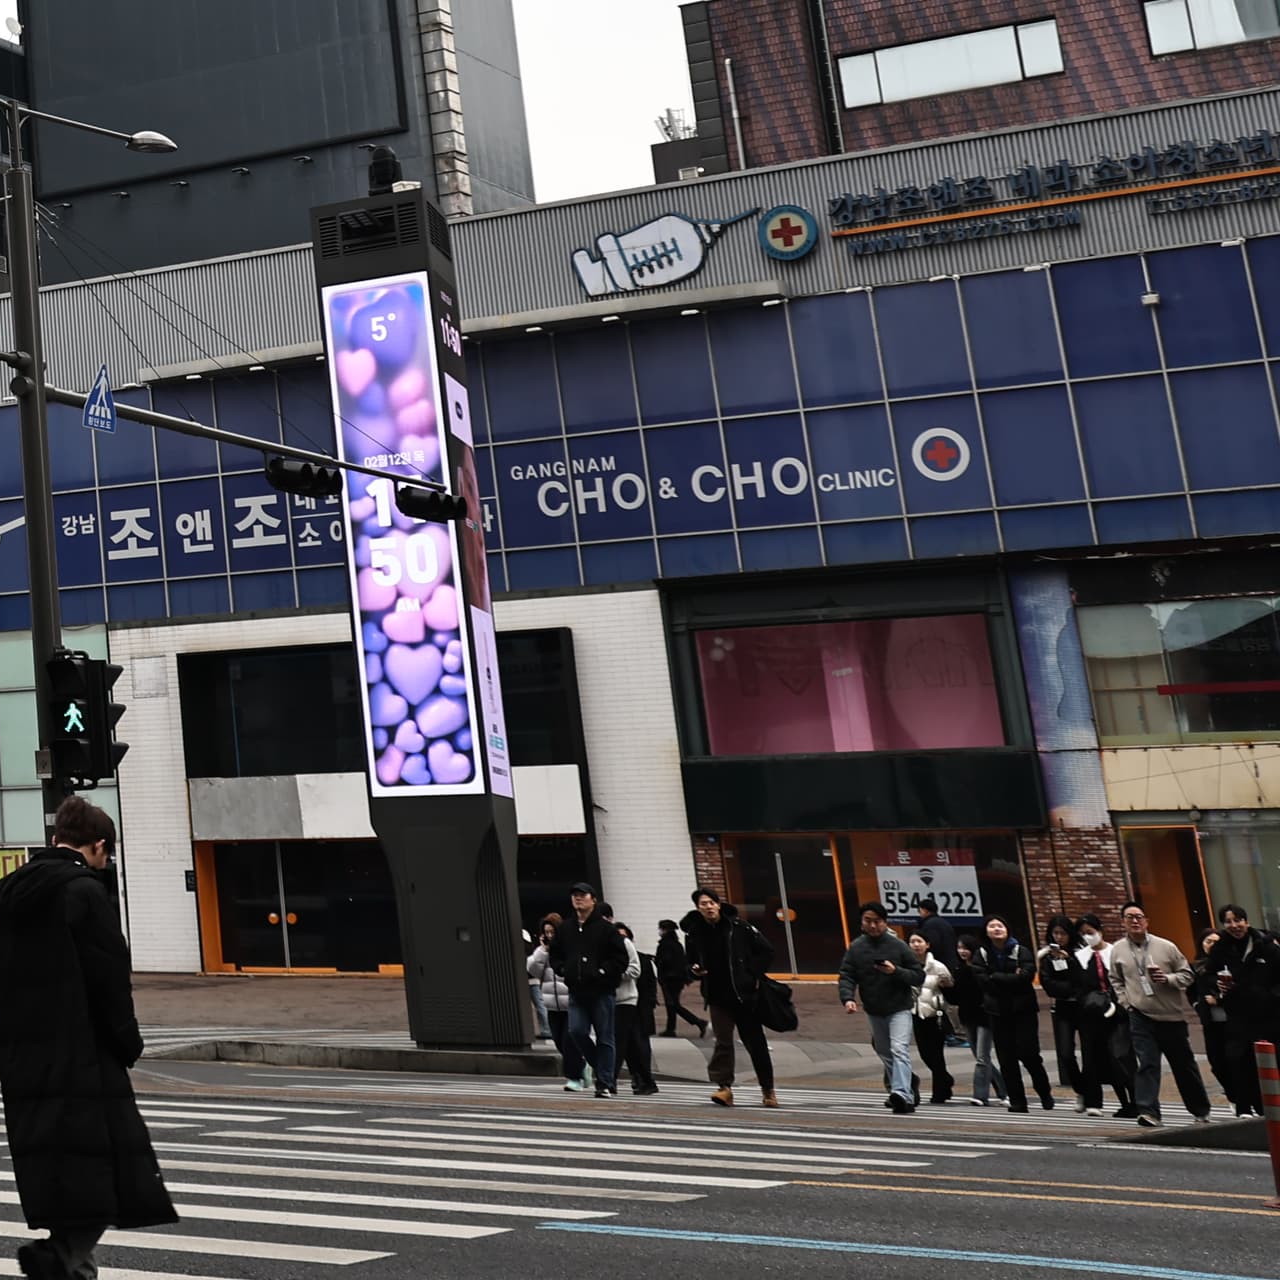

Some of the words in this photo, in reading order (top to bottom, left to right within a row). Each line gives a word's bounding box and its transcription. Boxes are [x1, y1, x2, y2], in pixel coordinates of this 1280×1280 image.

[510, 455, 617, 481] GANGNAM
[538, 472, 646, 518] CHO
[658, 477, 679, 500] &
[690, 457, 809, 503] CHO
[817, 467, 896, 493] CLINIC
[61, 513, 96, 537] 강남
[369, 532, 438, 587] 50
[883, 879, 900, 891] 02)
